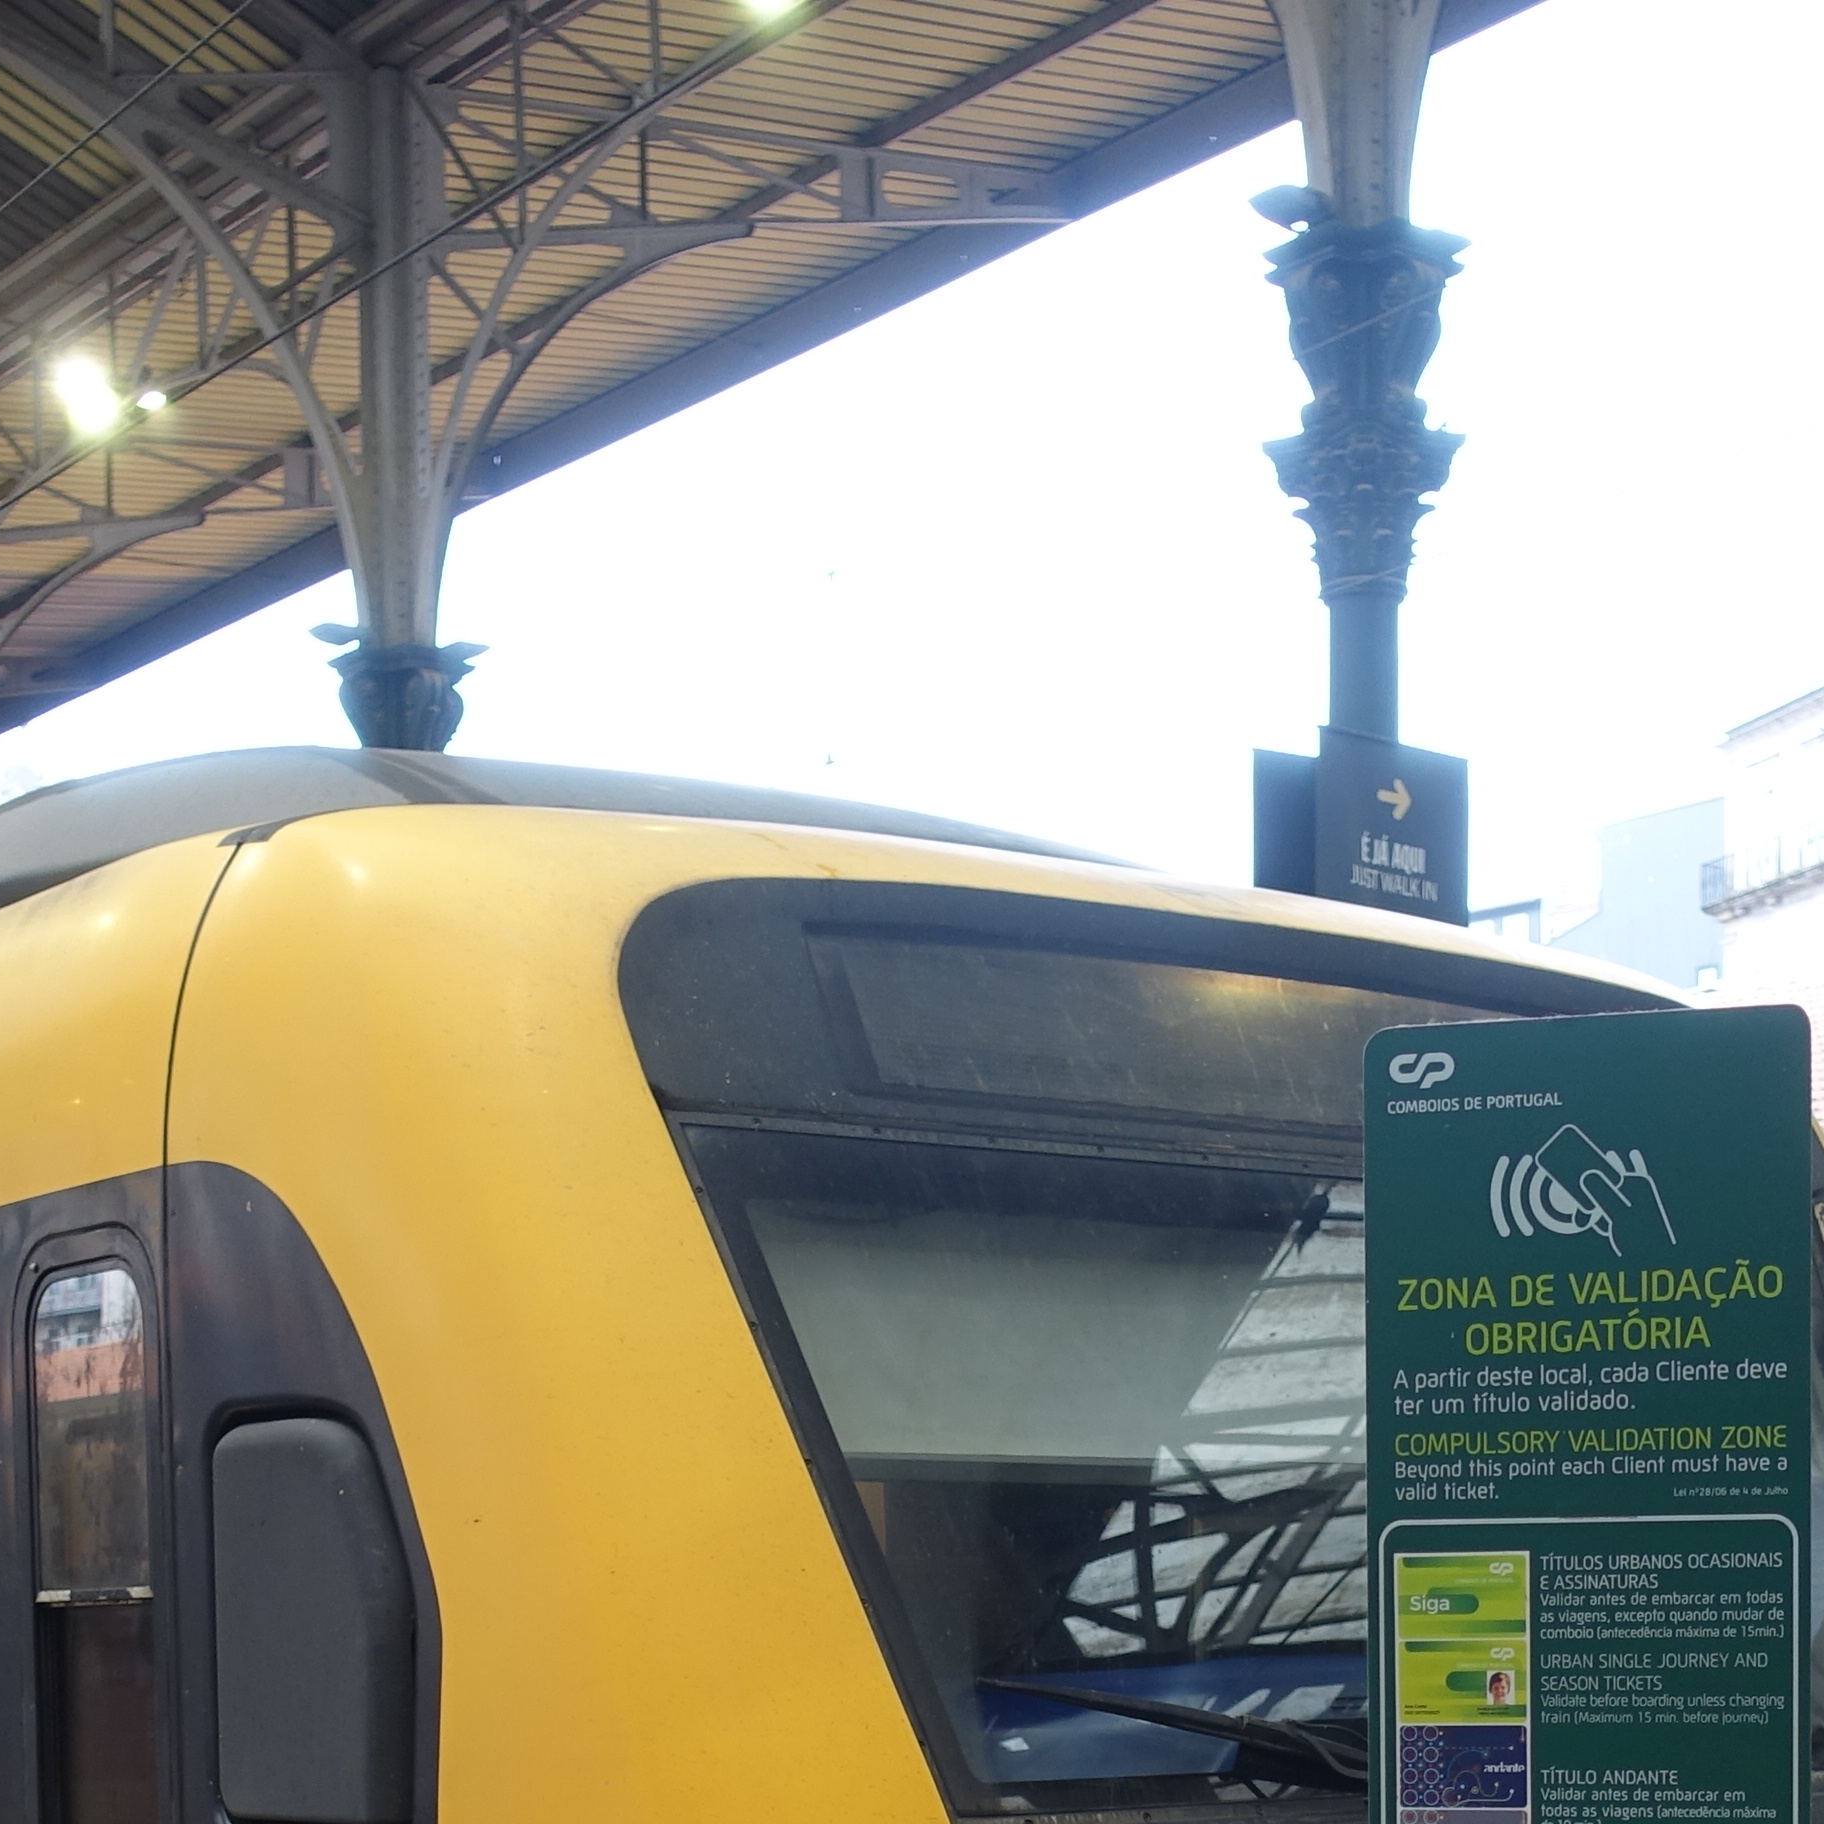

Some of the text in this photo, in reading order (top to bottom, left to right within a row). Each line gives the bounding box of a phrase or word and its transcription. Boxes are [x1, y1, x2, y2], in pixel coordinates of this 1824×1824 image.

[1391, 842, 1426, 875] AQUI
[1350, 864, 1379, 890] JUST
[1380, 871, 1421, 898] WALK
[1387, 1092, 1562, 1114] COMBOIOS DE PORTUGAL
[1397, 1259, 1783, 1311] ZONA DE VALIDAÇÃO
[1465, 1309, 1711, 1356] OBRIGATÓRIA
[1393, 1358, 1787, 1393] A partir deste local, cada Cliente deve
[1394, 1388, 1635, 1415] ter um título validado.
[1395, 1425, 1786, 1456] COMPULSORY VALIDATION ZONE
[1395, 1454, 1787, 1481] Beyond this point each Client must have a
[1395, 1481, 1499, 1500] valid ticket.
[1673, 1487, 1686, 1496] Lei
[1729, 1486, 1740, 1495] de
[1742, 1486, 1748, 1494] 4
[1750, 1486, 1762, 1495] de
[1764, 1486, 1788, 1495] Julho
[1539, 1551, 1782, 1570] TÍTULOS URBANOS OCASIONAIS
[1540, 1573, 1658, 1590] E ASSINATURAS
[1409, 1595, 1450, 1615] Siga
[1539, 1590, 1783, 1606] Validar antes de embarcar em todas
[1539, 1606, 1784, 1625] as viagens, excepto quando mudar de
[1540, 1624, 1784, 1640] comboio (antecedência máxima de 15min.)
[1540, 1652, 1767, 1669] URBAN SINGLE JOURNEY AND
[1540, 1675, 1662, 1691] SEASON TICKETS
[1540, 1692, 1784, 1710] Validate before boarding unless changing
[1540, 1710, 1768, 1725] train (Maximum 15 min. before journey)
[1483, 1761, 1525, 1773] andante
[1540, 1766, 1677, 1785] TÍTULO ANDANTE
[1540, 1787, 1745, 1801] Validar antes de embarcar em
[1540, 1803, 1776, 1820] todas as viagens (antecedência máxima
